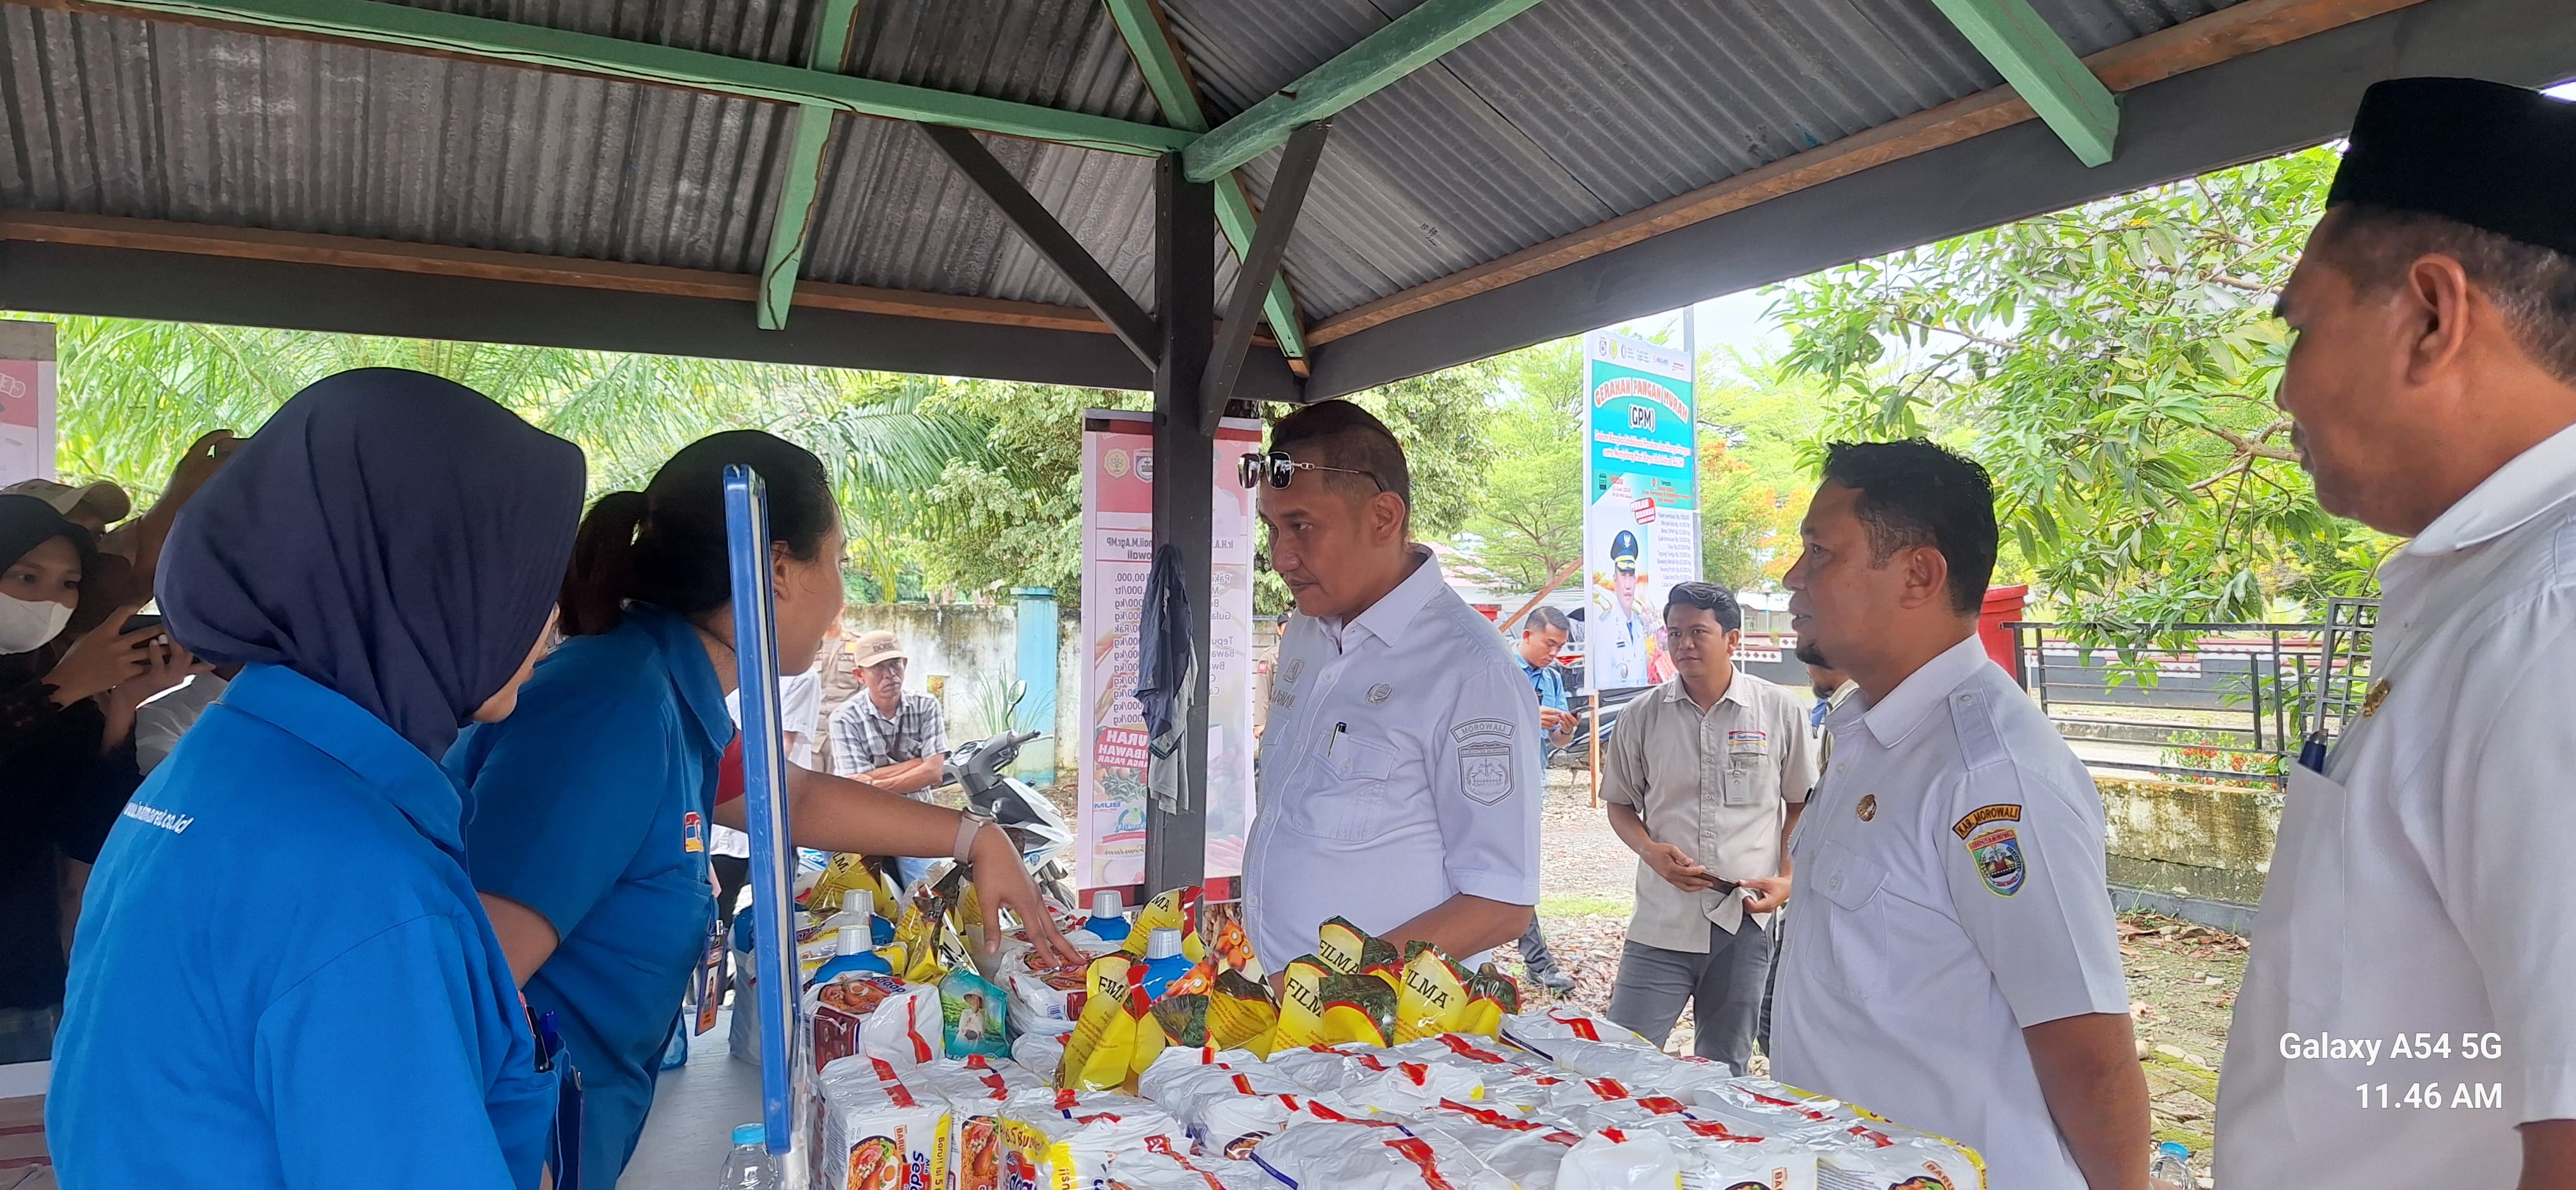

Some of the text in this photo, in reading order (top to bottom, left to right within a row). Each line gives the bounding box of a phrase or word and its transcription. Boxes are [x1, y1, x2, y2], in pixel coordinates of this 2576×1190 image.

[1595, 379, 1690, 421] GERAKAN PANGAN MURAH
[1629, 406, 1655, 431] (GPM)
[873, 643, 894, 652] BOSS
[1461, 723, 1506, 734] MOROWALI
[1957, 807, 2018, 835] KAB. MOROWALI
[1320, 940, 1360, 973] FILMA
